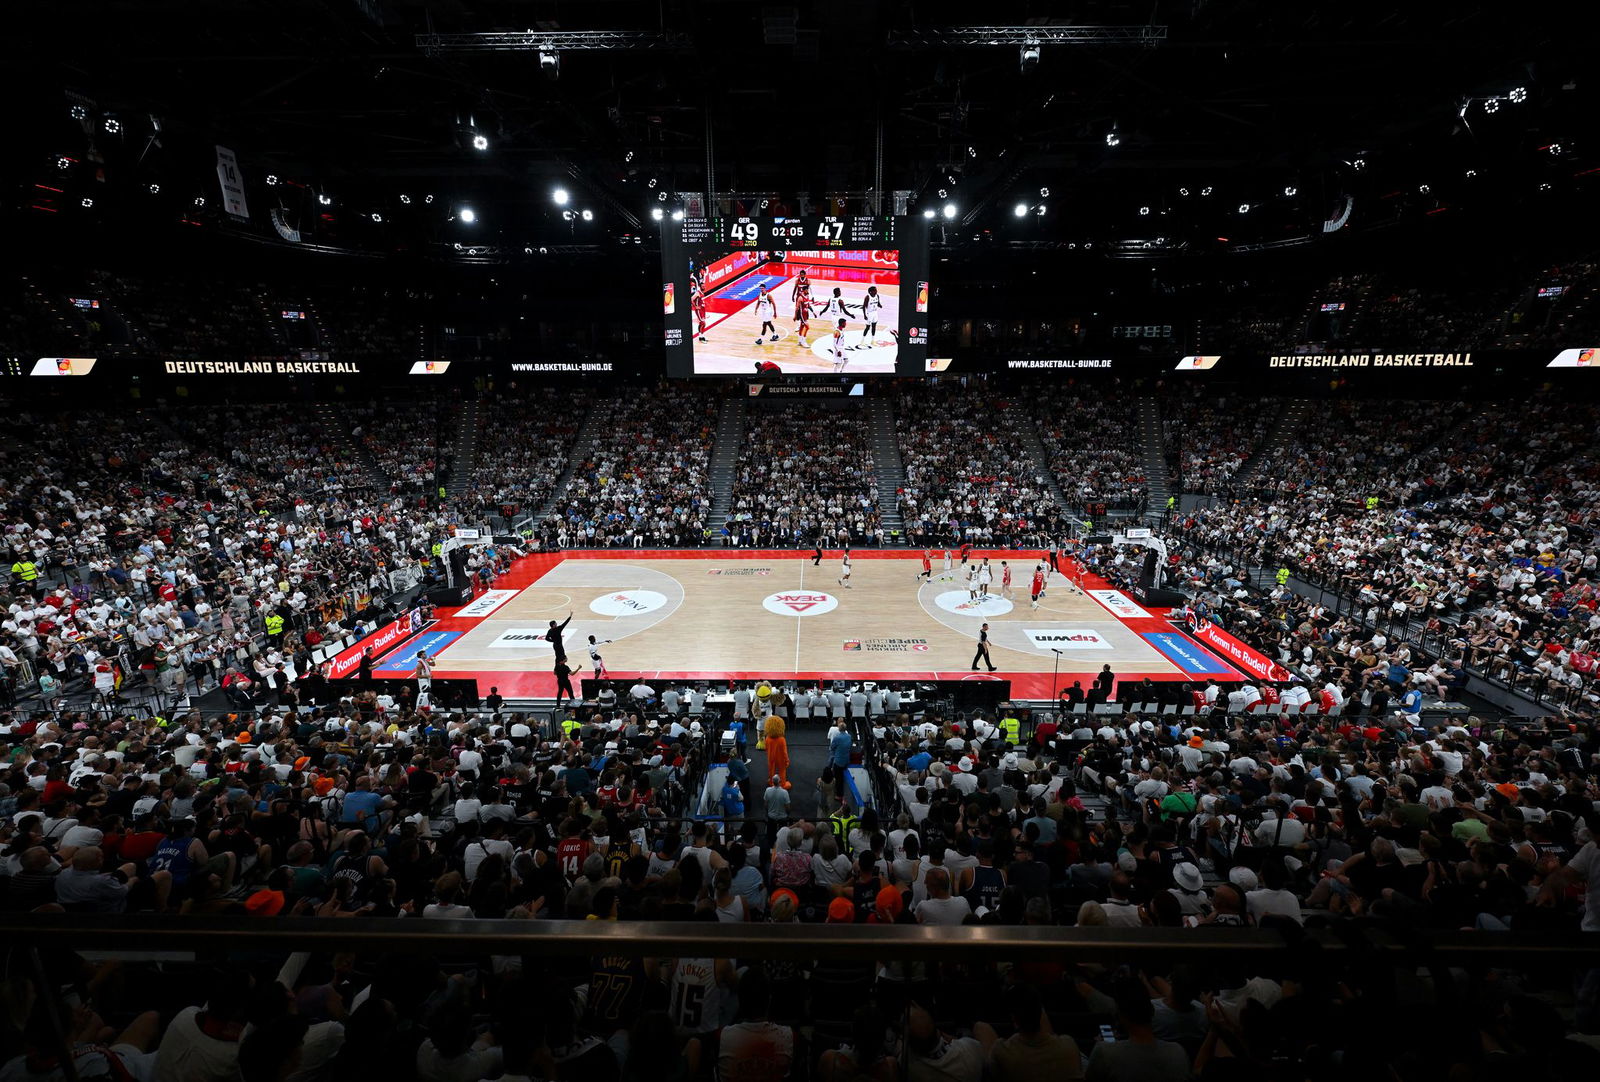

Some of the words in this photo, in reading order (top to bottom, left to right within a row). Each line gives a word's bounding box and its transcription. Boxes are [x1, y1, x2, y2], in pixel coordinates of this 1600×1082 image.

[222, 164, 236, 183] 14
[731, 223, 758, 240] 49
[772, 227, 803, 236] 02:05
[817, 223, 844, 240] 47
[165, 361, 272, 373] DEUTSCHLAND
[276, 362, 360, 373] BASKETBALL
[512, 363, 612, 372] WWW.BASKETBALL-BUND.DE
[1008, 360, 1111, 369] WWW.BASKETBALL-BUND.DE
[1270, 355, 1370, 368] DEUTSCHLAND
[1374, 354, 1474, 366] BASKETBALL
[623, 600, 648, 611] ING
[1034, 634, 1100, 643] tipwin
[336, 652, 362, 673] Komm
[374, 628, 395, 651] Rudel!
[1209, 630, 1230, 651] Komm
[1231, 643, 1242, 658] ins
[1242, 651, 1267, 675] Rudel!
[562, 855, 578, 876] 14
[592, 972, 633, 1020] 77
[676, 982, 705, 1028] 15
